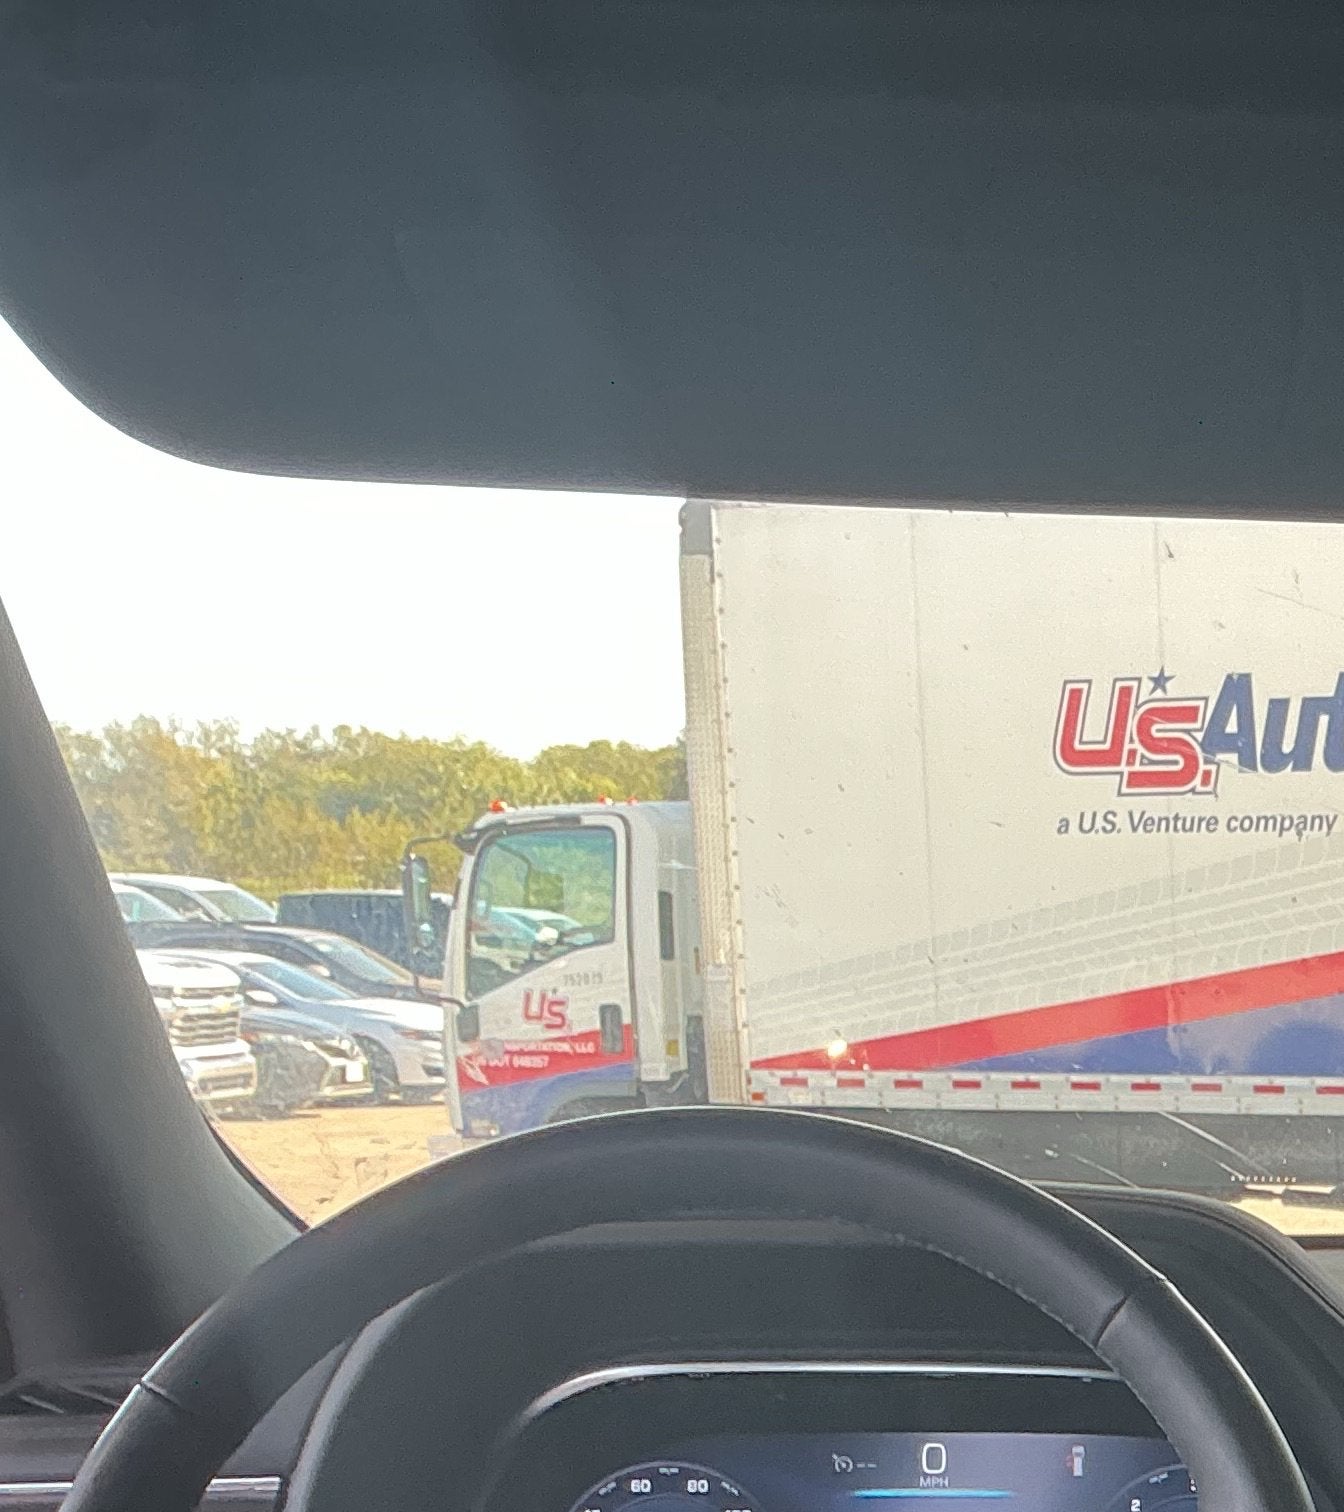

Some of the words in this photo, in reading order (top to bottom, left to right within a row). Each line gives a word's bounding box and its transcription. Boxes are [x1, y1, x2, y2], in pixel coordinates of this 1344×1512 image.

[1057, 817, 1070, 834] a
[1077, 812, 1123, 834] U.S.
[1128, 810, 1219, 835] Venture
[1225, 813, 1338, 838] company
[922, 1442, 947, 1475] 0
[630, 1479, 652, 1493] 60
[687, 1479, 709, 1493] 80
[919, 1476, 950, 1489] MPH
[1131, 1498, 1142, 1512] 2
